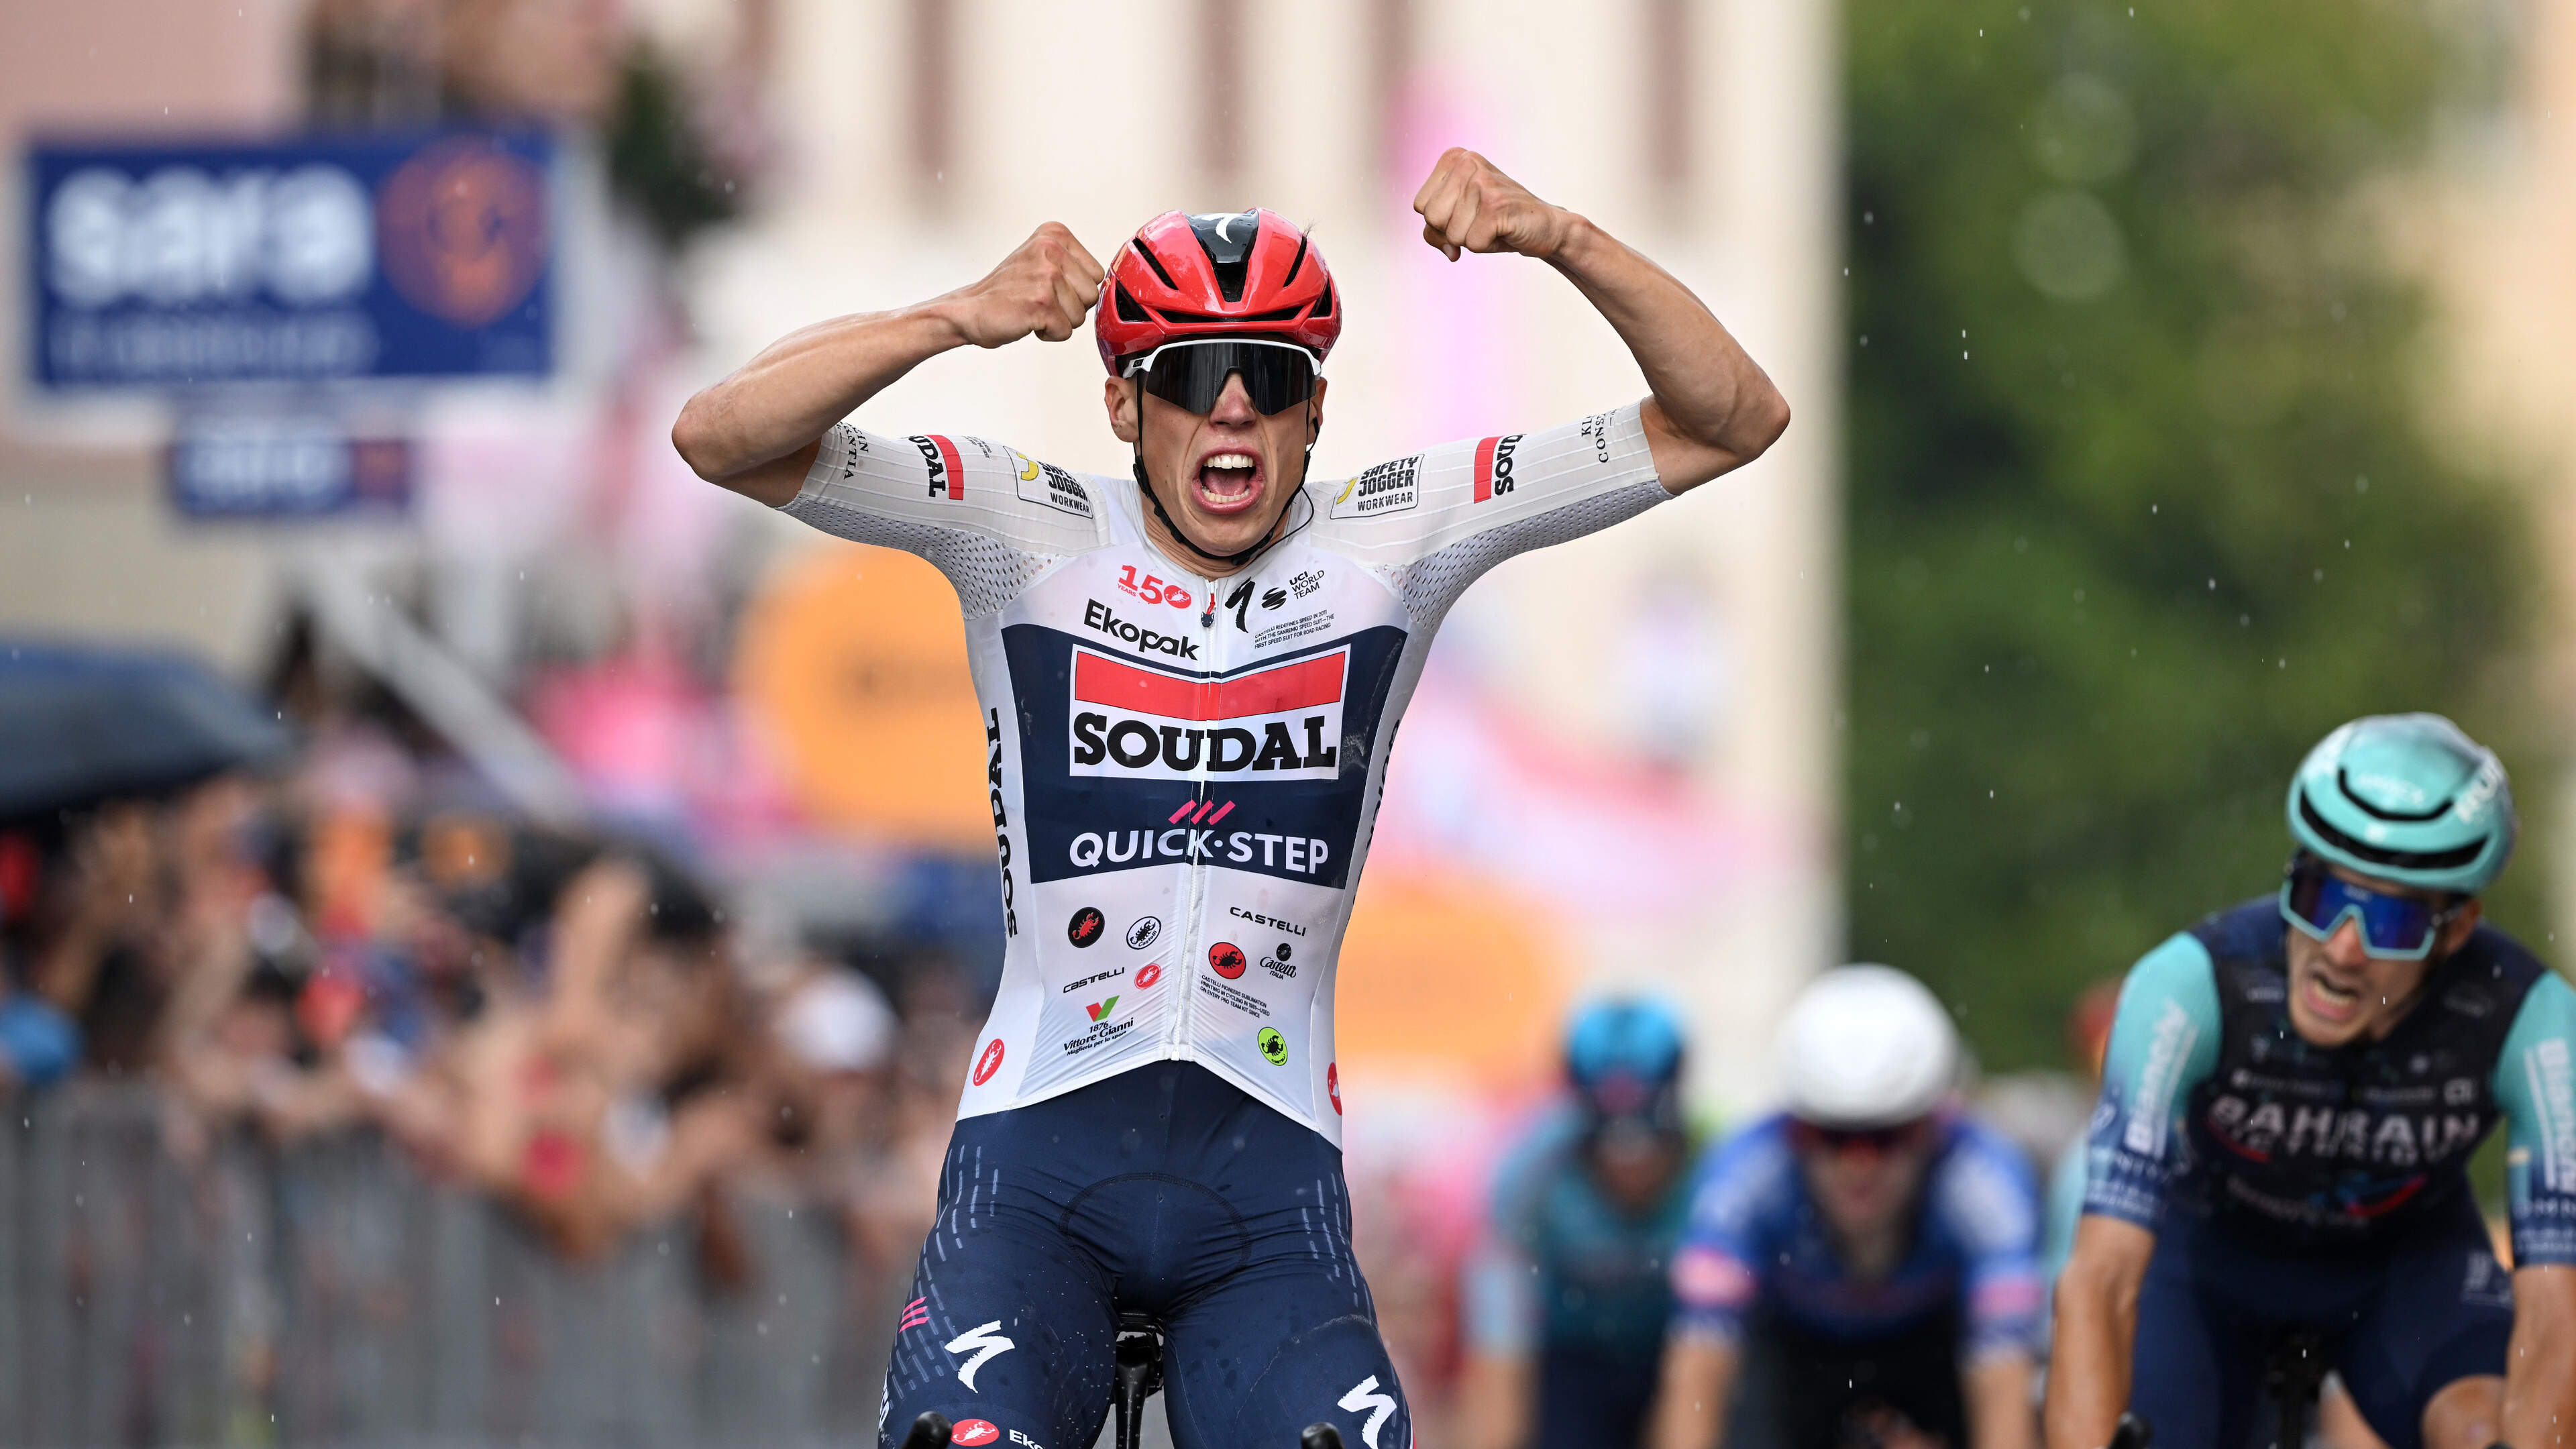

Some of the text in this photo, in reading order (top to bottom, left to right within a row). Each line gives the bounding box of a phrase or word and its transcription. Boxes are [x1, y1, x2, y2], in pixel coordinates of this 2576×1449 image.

[908, 435, 946, 497] UDAL
[1361, 456, 1419, 480] SAFETY
[1495, 434, 1524, 496] SOUD
[1358, 469, 1415, 496] JOGGER
[1050, 492, 1090, 513] WORKWEAR
[1358, 492, 1413, 511] WORKWEAR
[1117, 584, 1137, 597] YEARS
[1289, 570, 1308, 586] UCI
[1291, 570, 1325, 592] WORLD
[1294, 582, 1320, 599] TEAM
[1084, 598, 1200, 661] Ekopak
[1254, 626, 1275, 639] CASTELLI
[1275, 619, 1299, 630] REDEFINES
[1299, 614, 1313, 624] SPEED
[1254, 635, 1267, 643] WITH
[1277, 626, 1299, 636] SANREMO
[1299, 621, 1313, 630] SPEED
[1254, 641, 1267, 649] FIRST
[1268, 637, 1282, 645] SPEED
[1283, 633, 1293, 641] SUIT
[1303, 627, 1316, 635] ROAD
[1315, 622, 1332, 631] RACING
[1073, 712, 1336, 771] SOUDAL
[987, 707, 1018, 938] SOUDAL
[1230, 906, 1306, 936] CASTELLI
[1260, 956, 1297, 978] Castelli
[1269, 970, 1284, 980] ITALIA
[1200, 985, 1207, 994] ON
[1207, 989, 1221, 1000] EVERY
[1221, 996, 1230, 1005] PRO
[1230, 1001, 1242, 1010] TEAM
[1201, 975, 1221, 987] CASTELLI
[1241, 993, 1267, 1008] SUBLIMATION
[1201, 980, 1220, 994] PRINTING
[1226, 992, 1244, 1004] CYCLING
[1063, 1017, 1134, 1051] Vittore Gianni
[1089, 1020, 1109, 1034] 1876
[1067, 1044, 1093, 1057] Maglieria
[1093, 1040, 1104, 1048] per
[1112, 1030, 1127, 1040] sport
